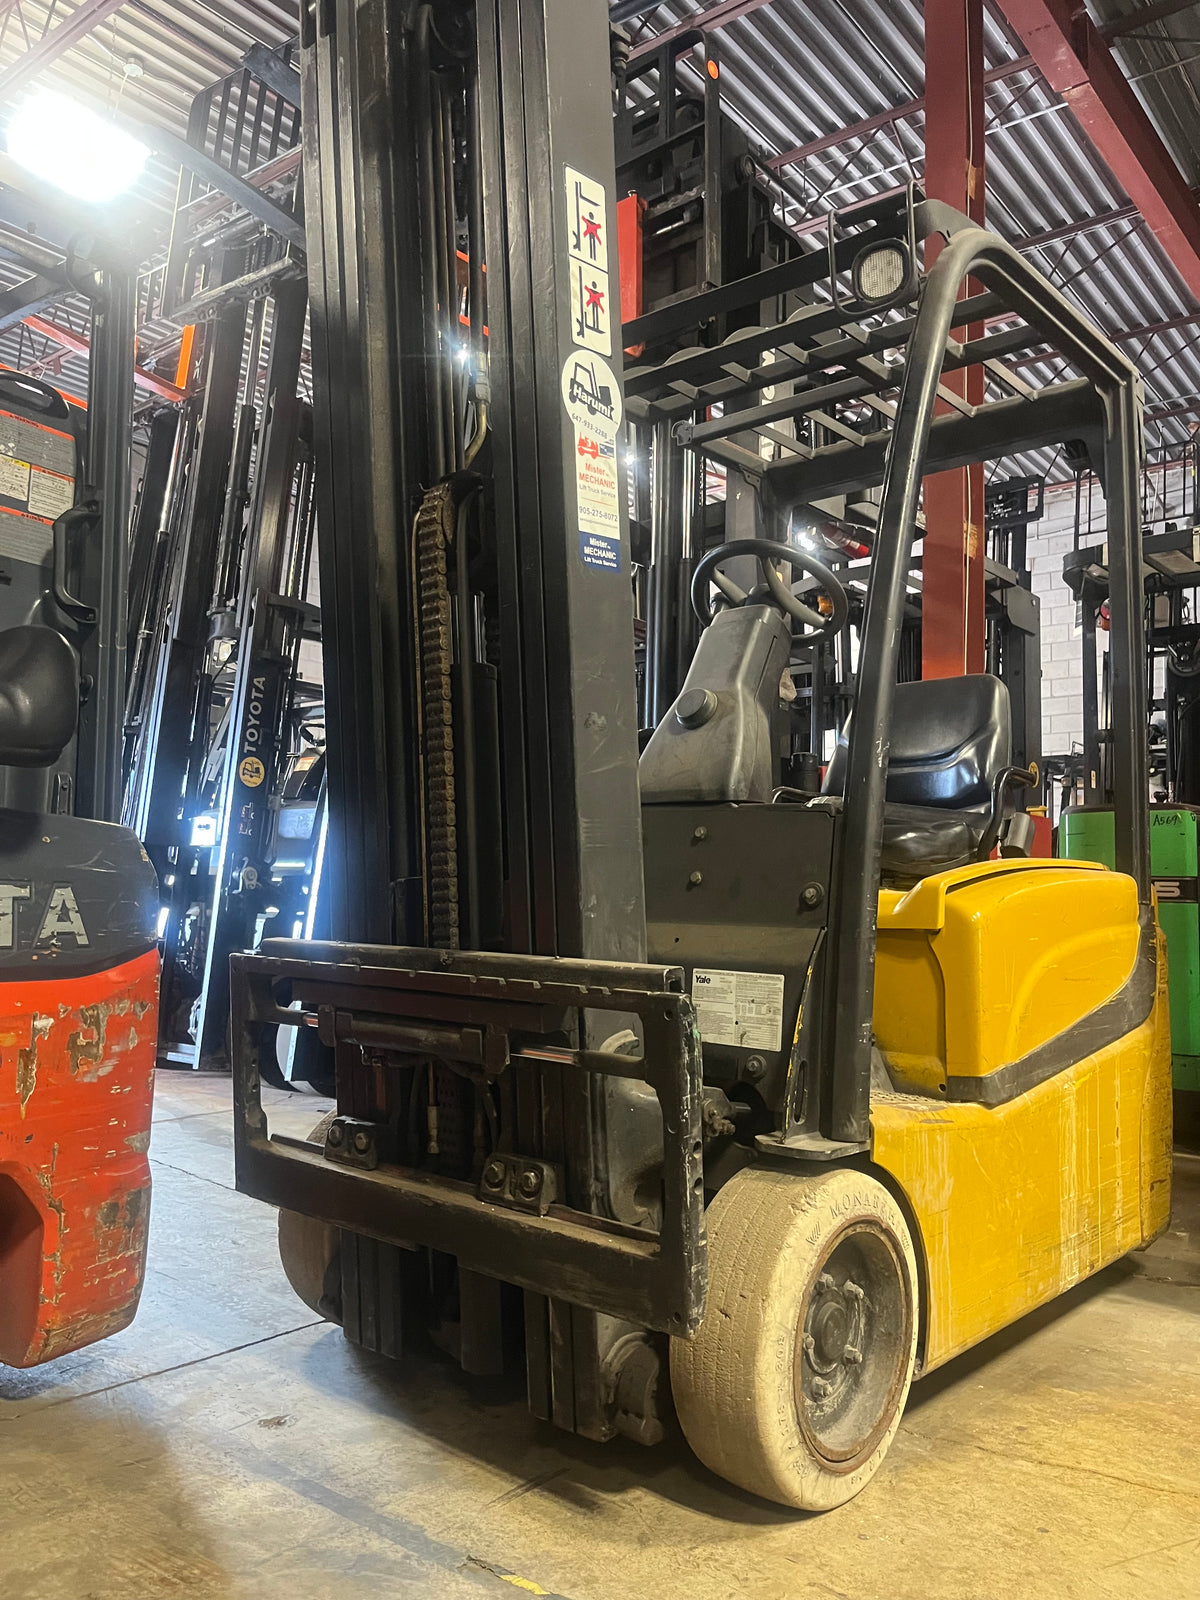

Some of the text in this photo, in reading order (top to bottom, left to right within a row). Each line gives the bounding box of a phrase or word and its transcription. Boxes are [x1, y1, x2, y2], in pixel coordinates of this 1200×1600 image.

[573, 383, 611, 417] Harumi
[585, 463, 606, 477] Mister
[579, 472, 615, 489] MECHANIC
[579, 506, 618, 522] 905-275-8072
[589, 537, 608, 549] Mister
[583, 546, 617, 560] MECHANIC
[244, 676, 266, 754] TOYOTA
[695, 975, 711, 984] Yale
